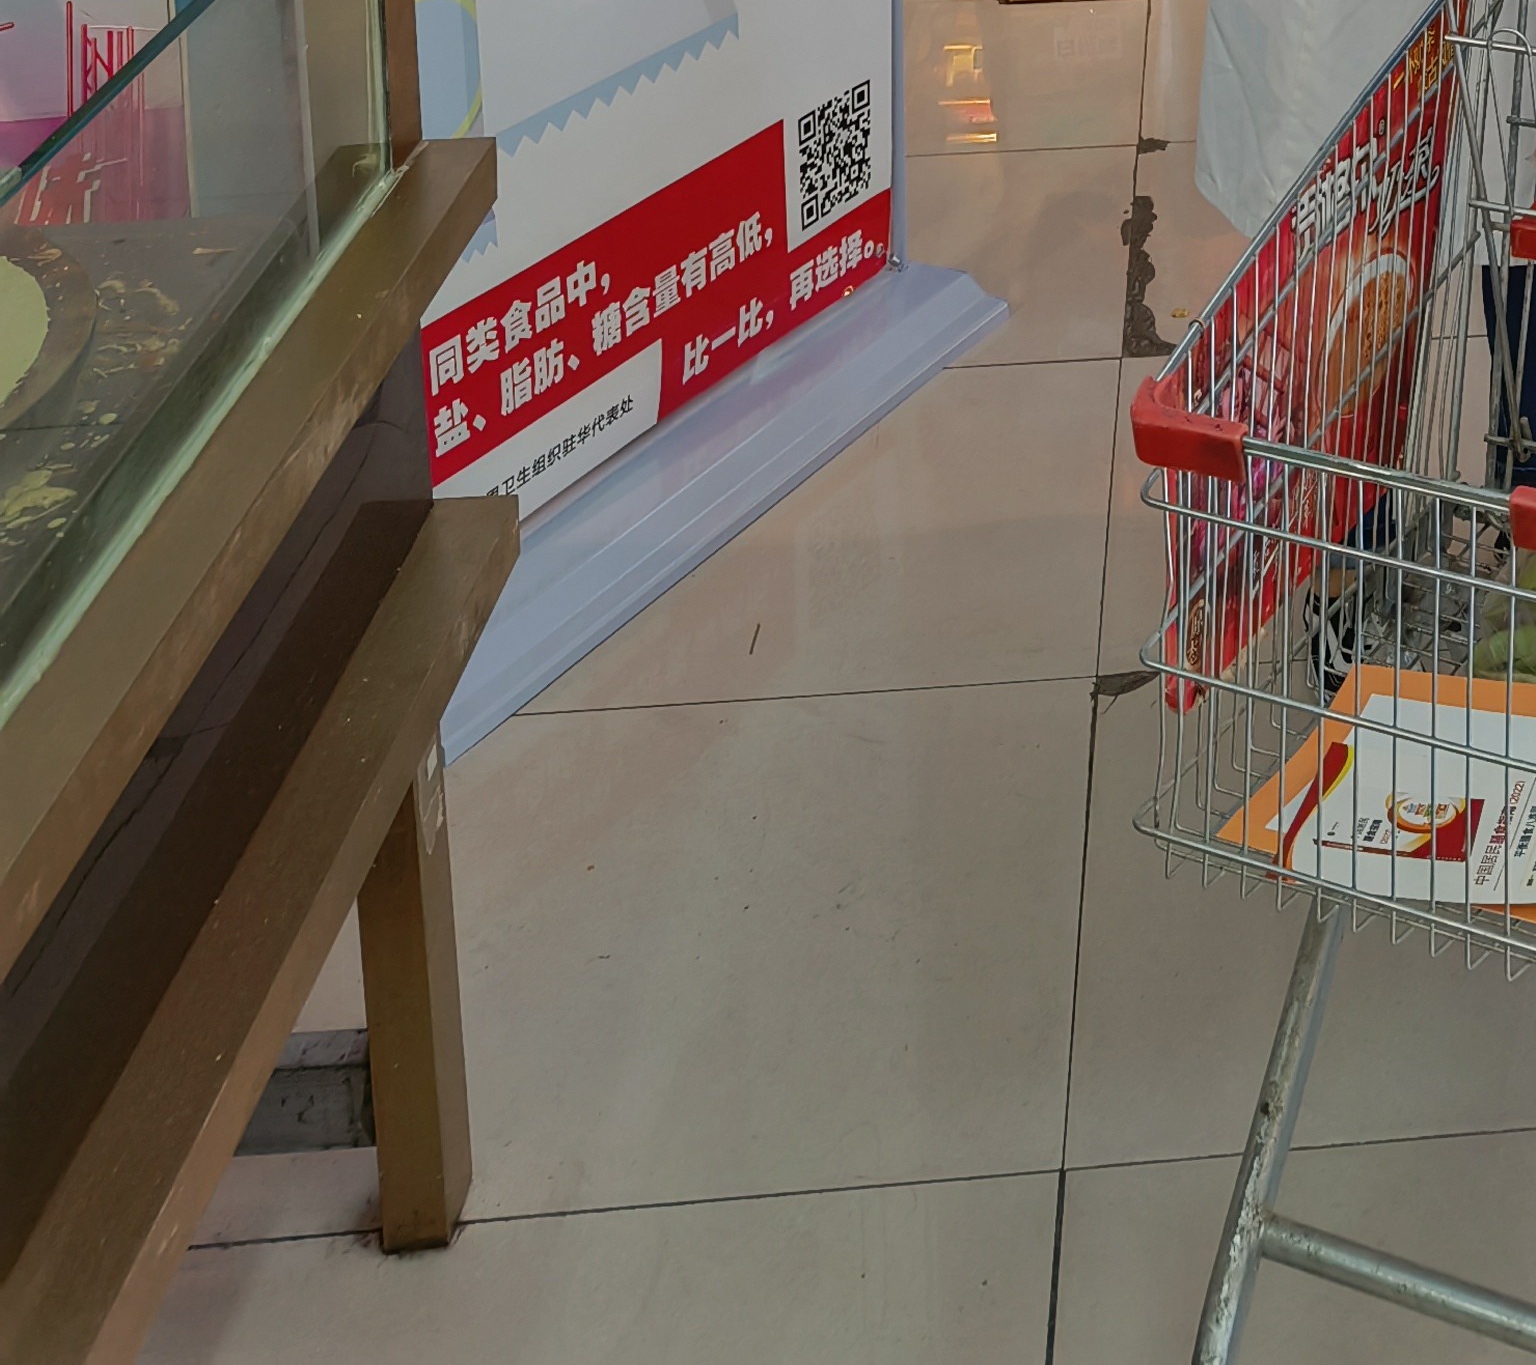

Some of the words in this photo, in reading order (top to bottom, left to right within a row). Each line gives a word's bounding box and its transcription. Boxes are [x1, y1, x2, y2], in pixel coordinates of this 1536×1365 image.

[428, 262, 611, 396] 同类食品中，
